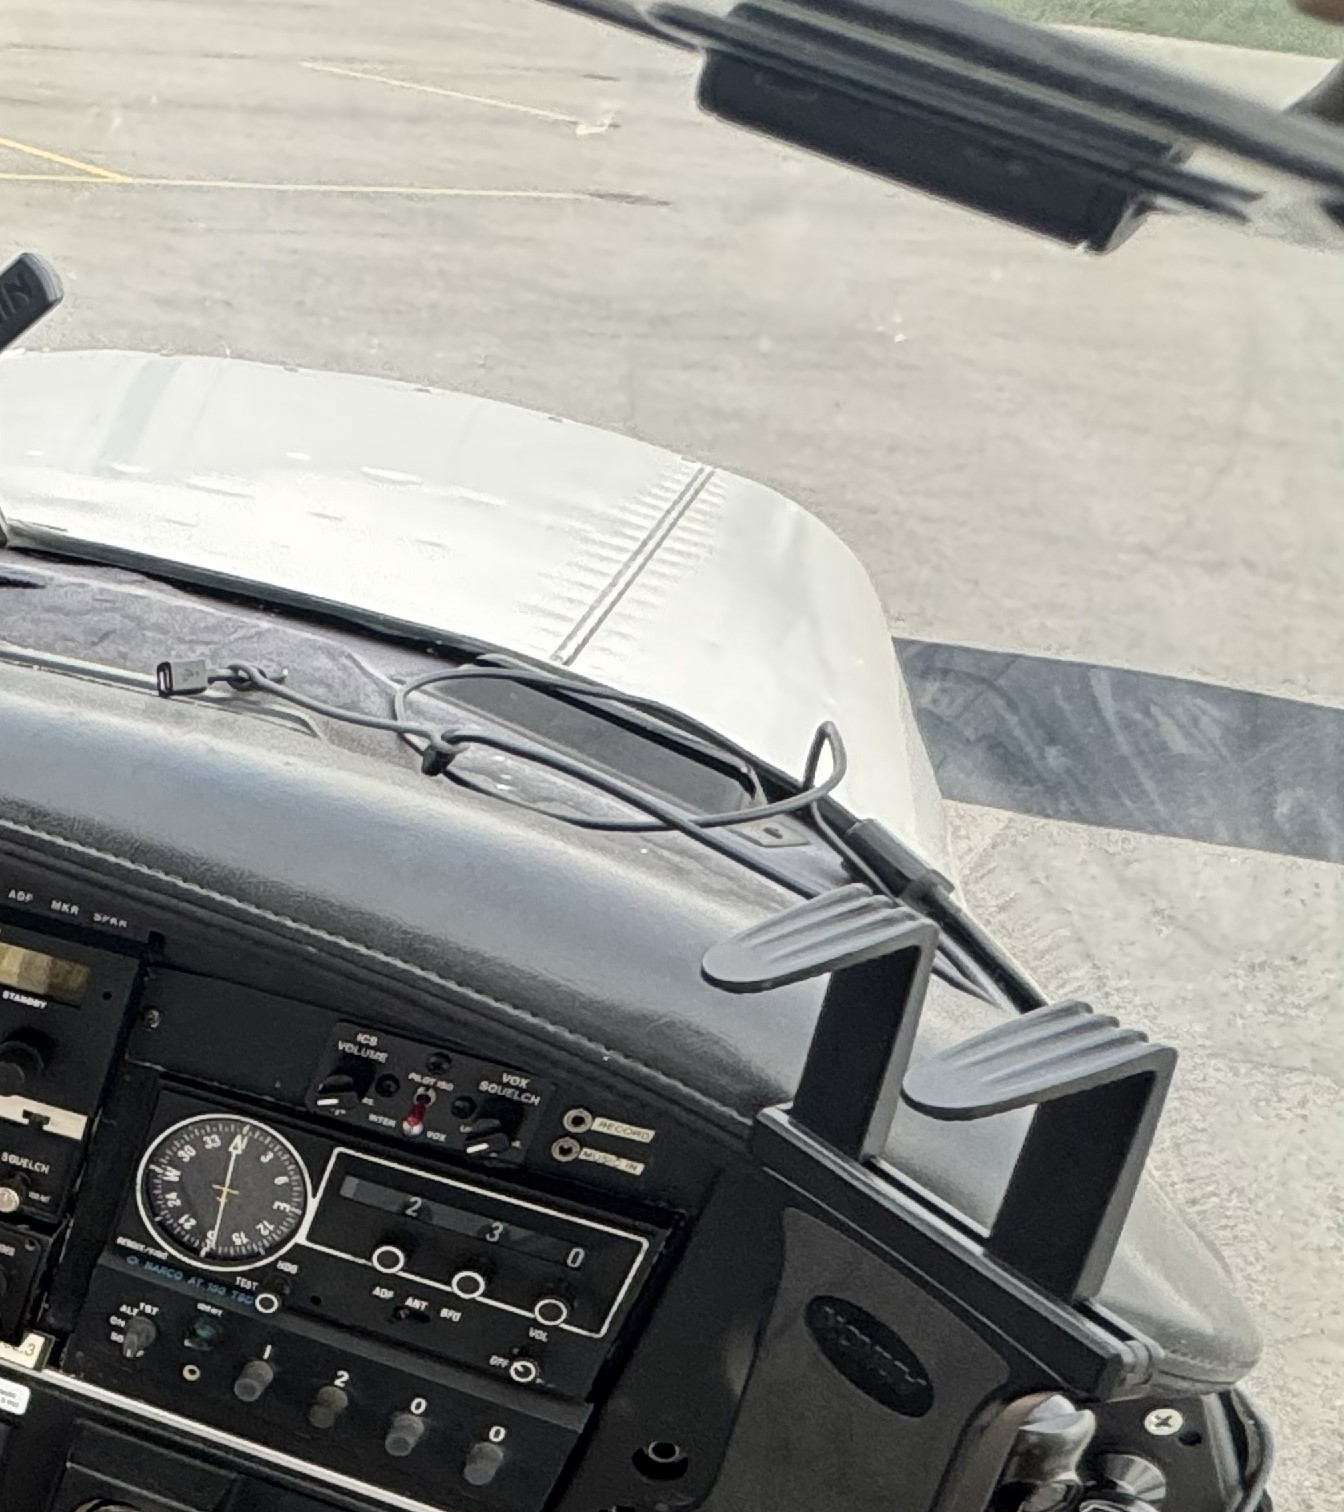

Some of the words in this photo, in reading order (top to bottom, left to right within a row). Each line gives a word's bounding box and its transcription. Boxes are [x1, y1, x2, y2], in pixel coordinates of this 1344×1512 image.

[51, 900, 80, 916] MKR
[2, 990, 48, 1010] STANDBY
[356, 1032, 379, 1047] ICS
[338, 1040, 389, 1064] VOLUME
[408, 1072, 437, 1087] PILOT
[502, 1072, 531, 1089] VOX
[478, 1080, 541, 1106] SQUELCH
[426, 1130, 448, 1142] VOX
[598, 1120, 650, 1140] RECORD
[203, 1134, 222, 1149] 33
[177, 1144, 197, 1162] 30
[260, 1151, 274, 1164] 3
[1, 1151, 50, 1174] SQUELCH
[162, 1167, 182, 1182] W
[164, 1192, 182, 1208] 24
[272, 1200, 291, 1213] E
[404, 1196, 423, 1217] 2
[178, 1213, 197, 1230] 21
[255, 1219, 276, 1236] 12
[231, 1231, 250, 1246] 15
[485, 1221, 504, 1242] 3
[566, 1247, 586, 1268] 0
[144, 1261, 184, 1281] NARCO
[235, 1276, 259, 1291] TEST
[372, 1286, 395, 1299] ADF
[119, 1303, 139, 1317] ALT
[139, 1302, 160, 1315] TST
[404, 1296, 429, 1312] ANT
[528, 1327, 548, 1342] VOL
[334, 1369, 350, 1388] 2
[410, 1398, 428, 1415] 0
[488, 1425, 506, 1443] 0
